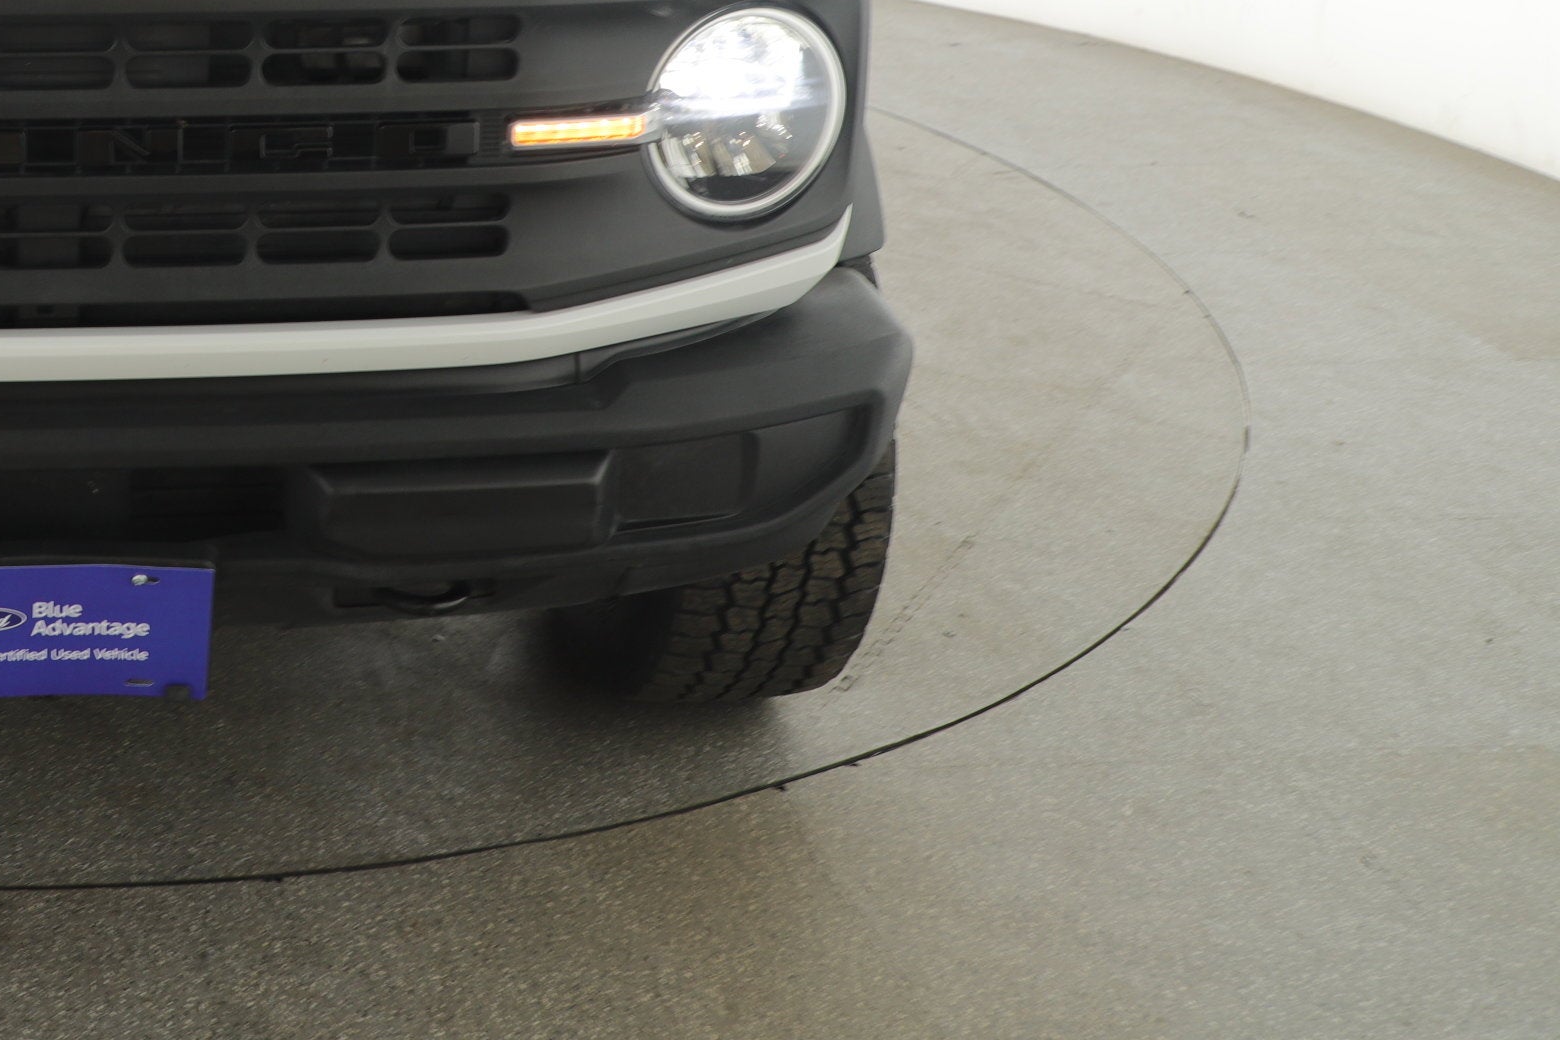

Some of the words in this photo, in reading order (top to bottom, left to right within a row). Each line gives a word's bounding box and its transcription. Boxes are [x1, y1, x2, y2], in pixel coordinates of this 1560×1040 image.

[32, 601, 83, 619] Blue
[30, 619, 150, 638] Advantage
[51, 647, 91, 661] Used
[93, 647, 150, 661] Vehicle
